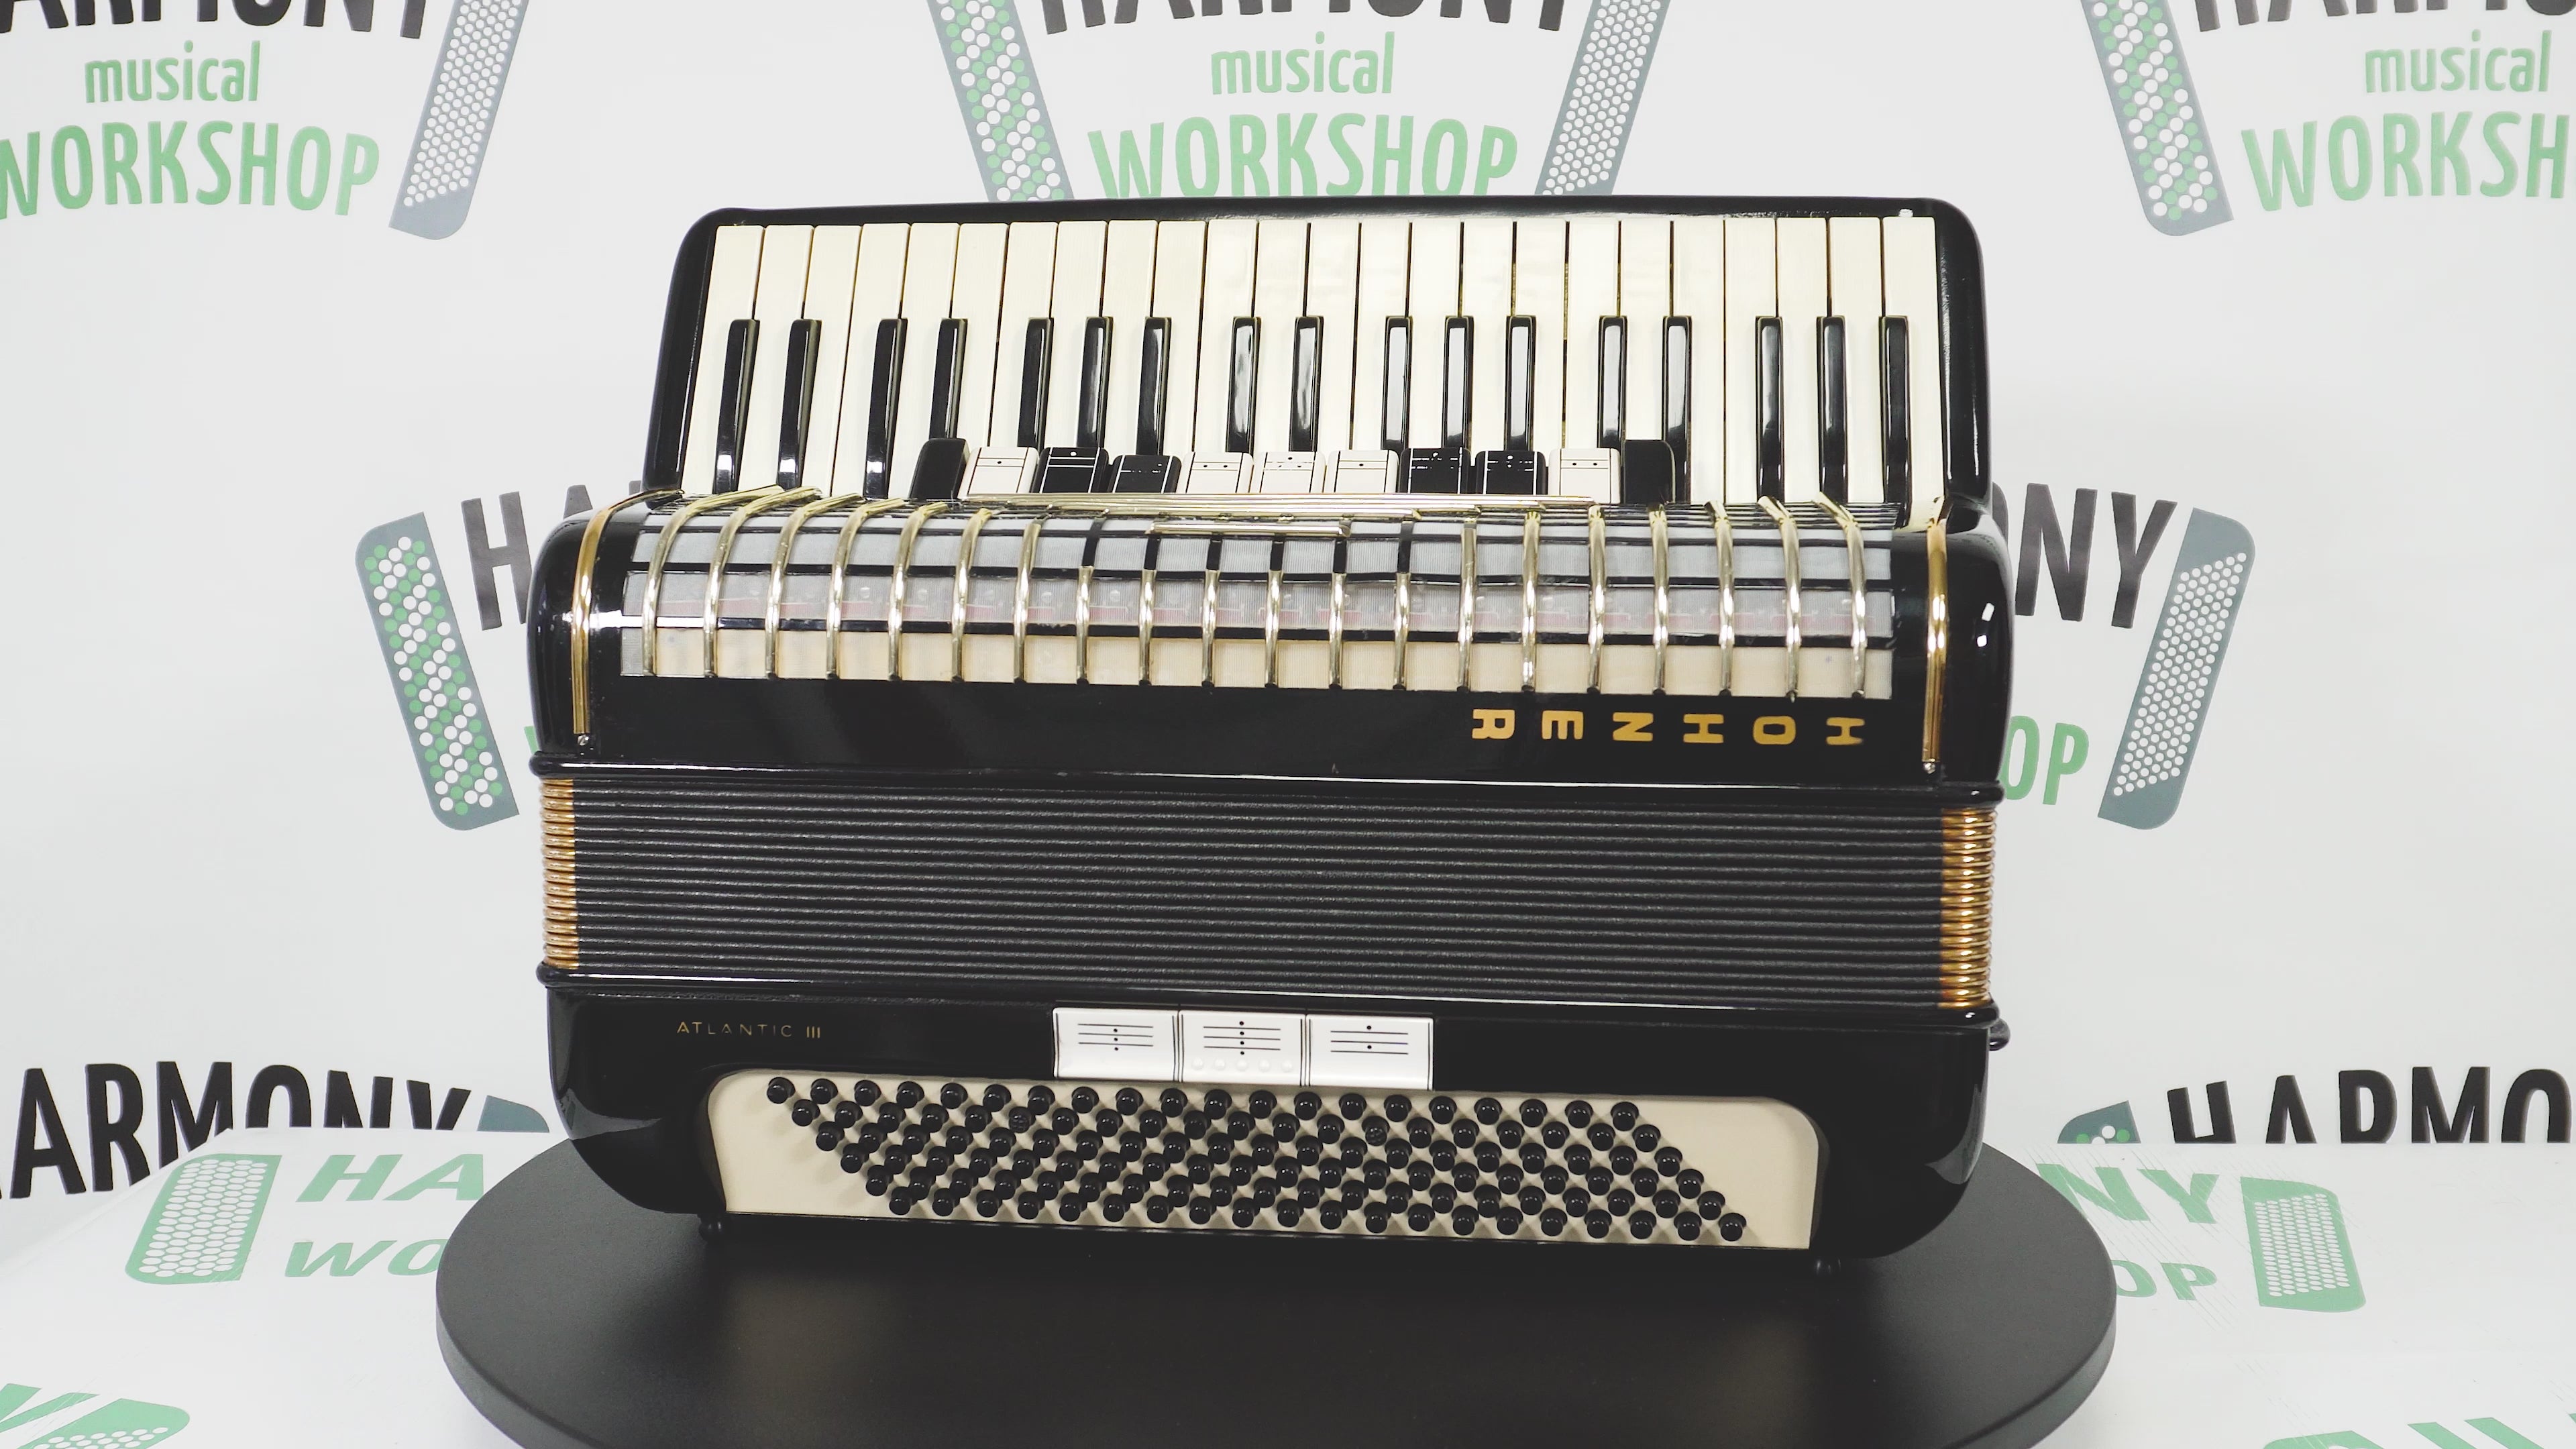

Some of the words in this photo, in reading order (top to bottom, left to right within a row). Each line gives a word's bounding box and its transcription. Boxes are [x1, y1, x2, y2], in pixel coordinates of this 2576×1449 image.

[85, 40, 260, 103] musical
[1212, 31, 1395, 95] musical
[2365, 30, 2551, 93] musical
[1087, 113, 1517, 197] WORKSHOP
[676, 1021, 792, 1037] ATLANTIC
